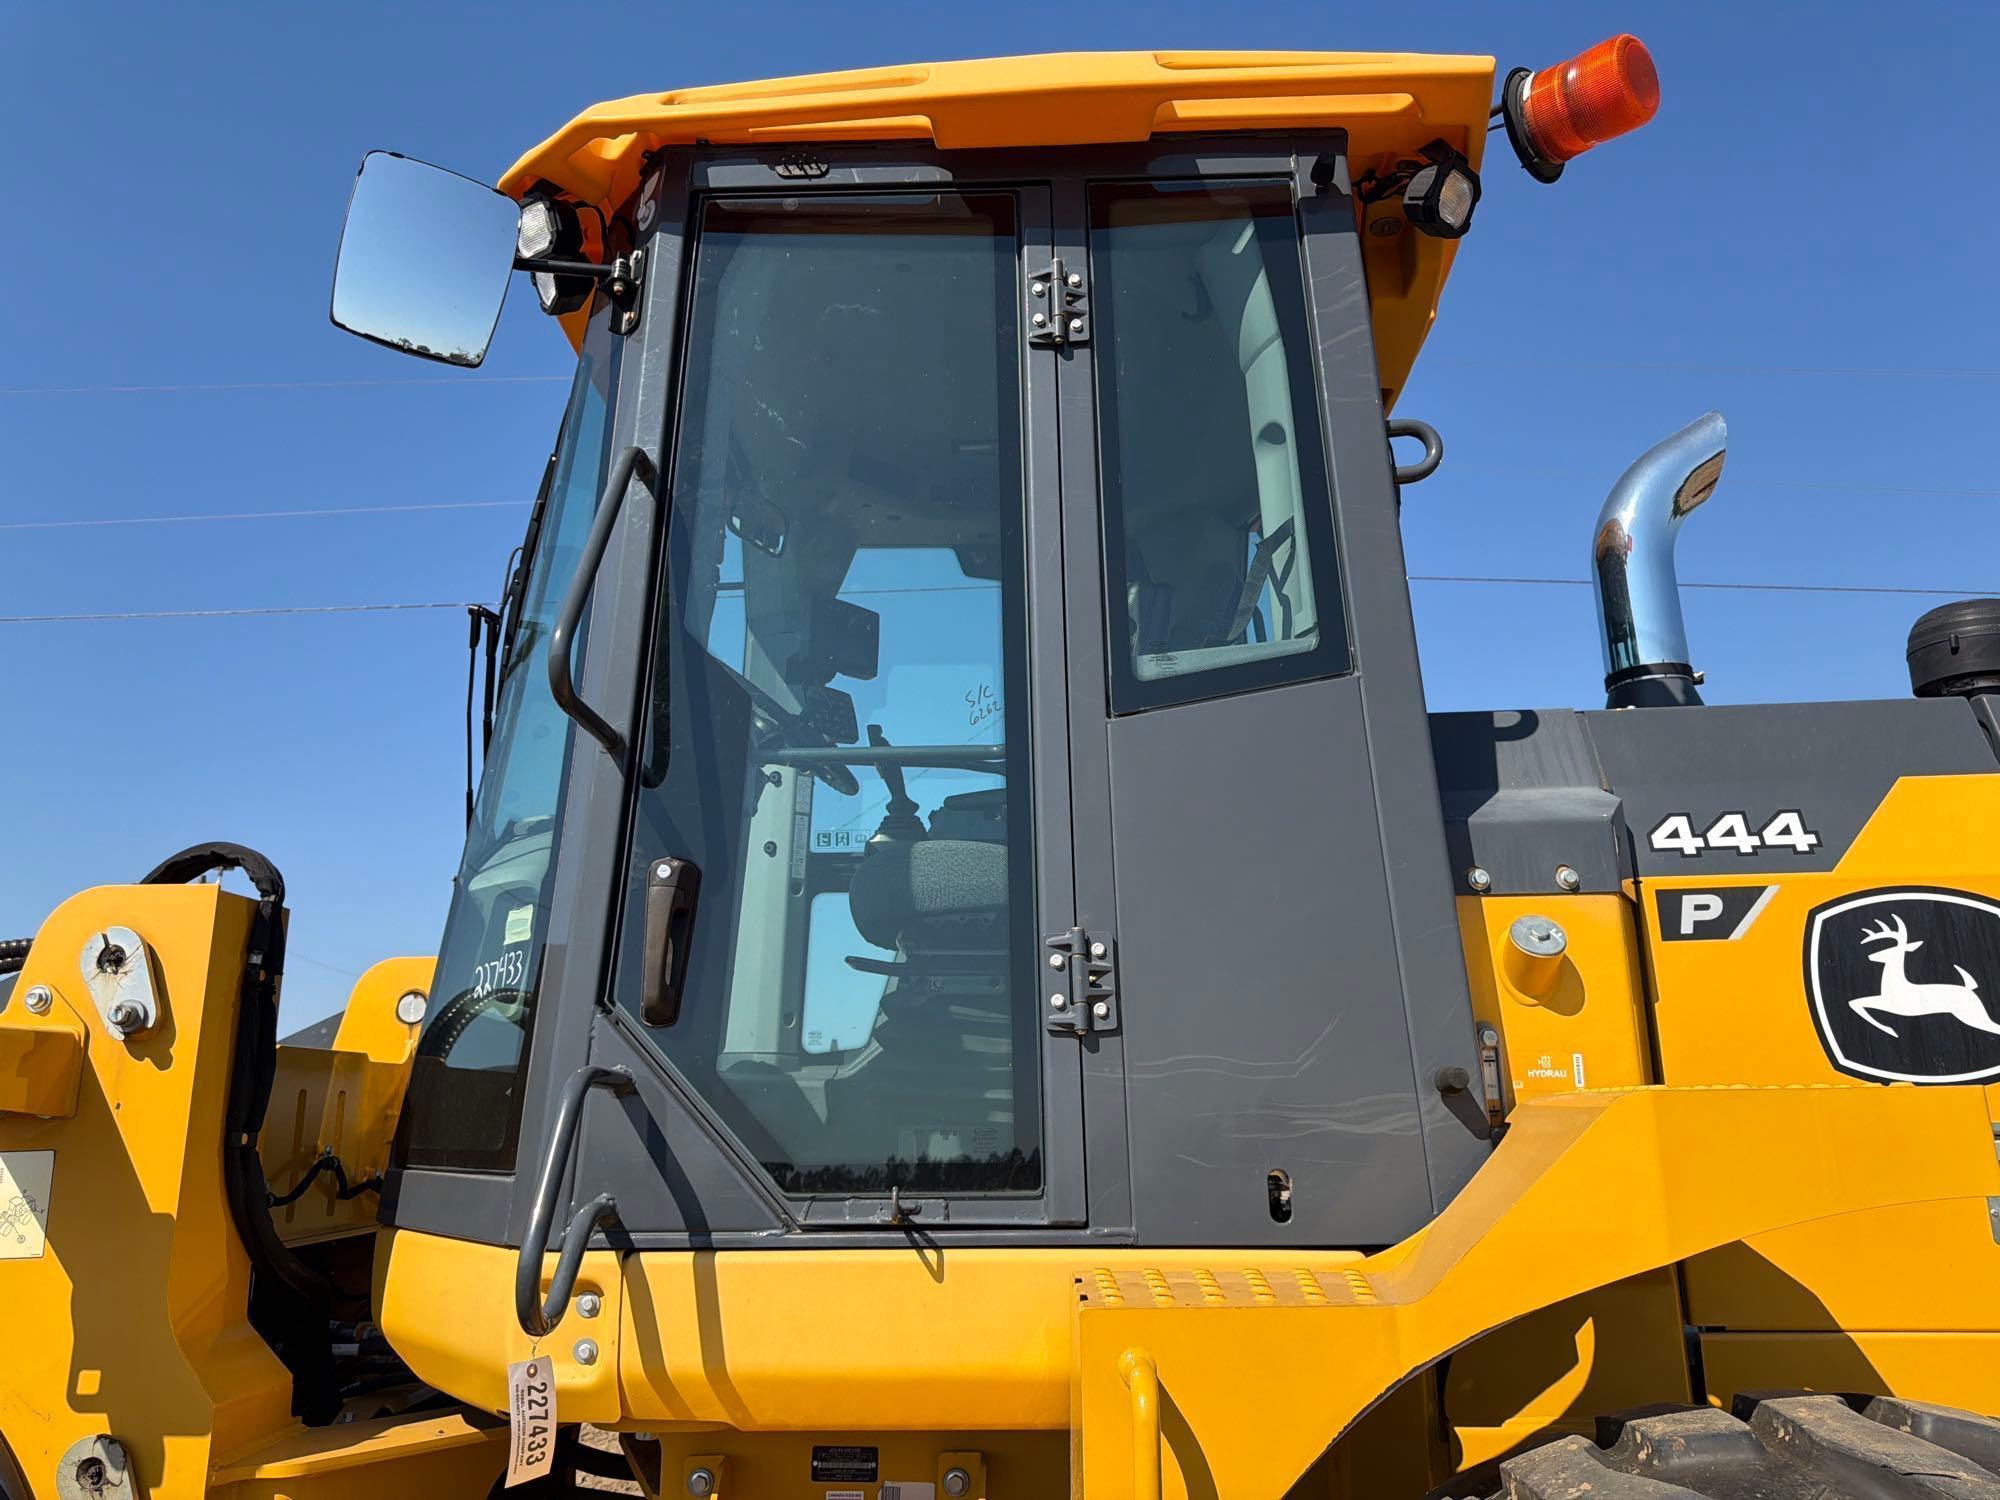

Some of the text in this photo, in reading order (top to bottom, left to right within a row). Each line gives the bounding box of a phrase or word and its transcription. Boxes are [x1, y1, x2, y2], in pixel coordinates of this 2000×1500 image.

[1648, 809, 1821, 857] 444
[1680, 894, 1724, 935] P
[473, 950, 523, 999] 227433
[1527, 1069, 1568, 1078] HYDRAU
[525, 1381, 549, 1466] 227433
